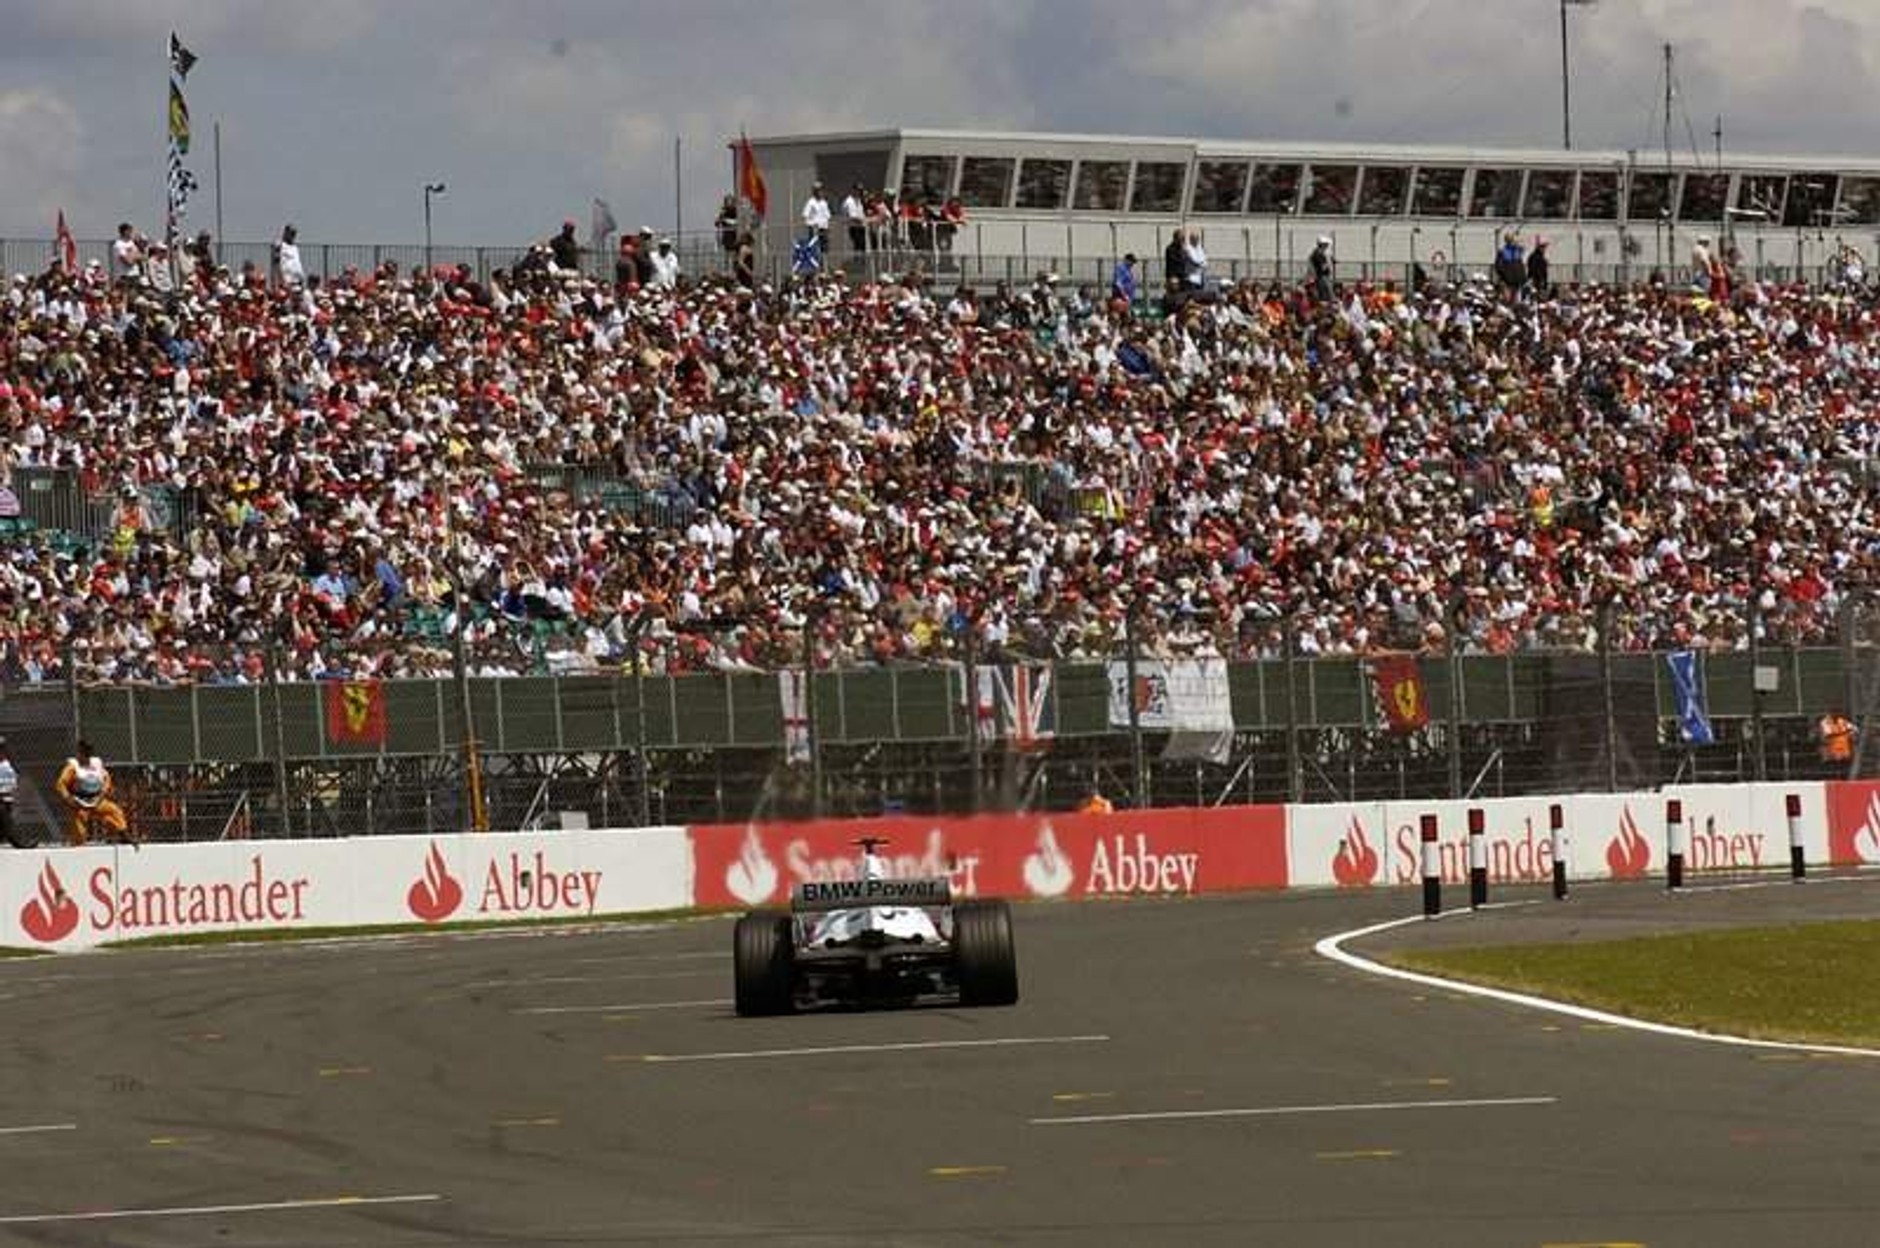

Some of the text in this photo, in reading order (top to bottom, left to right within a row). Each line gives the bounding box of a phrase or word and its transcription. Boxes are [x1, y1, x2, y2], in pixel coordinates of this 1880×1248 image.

[1086, 834, 1199, 893] Abbey
[1680, 814, 1764, 867] bbey
[89, 853, 309, 933] Santander
[479, 852, 603, 916] Abbey
[803, 879, 937, 902] BMW Power
